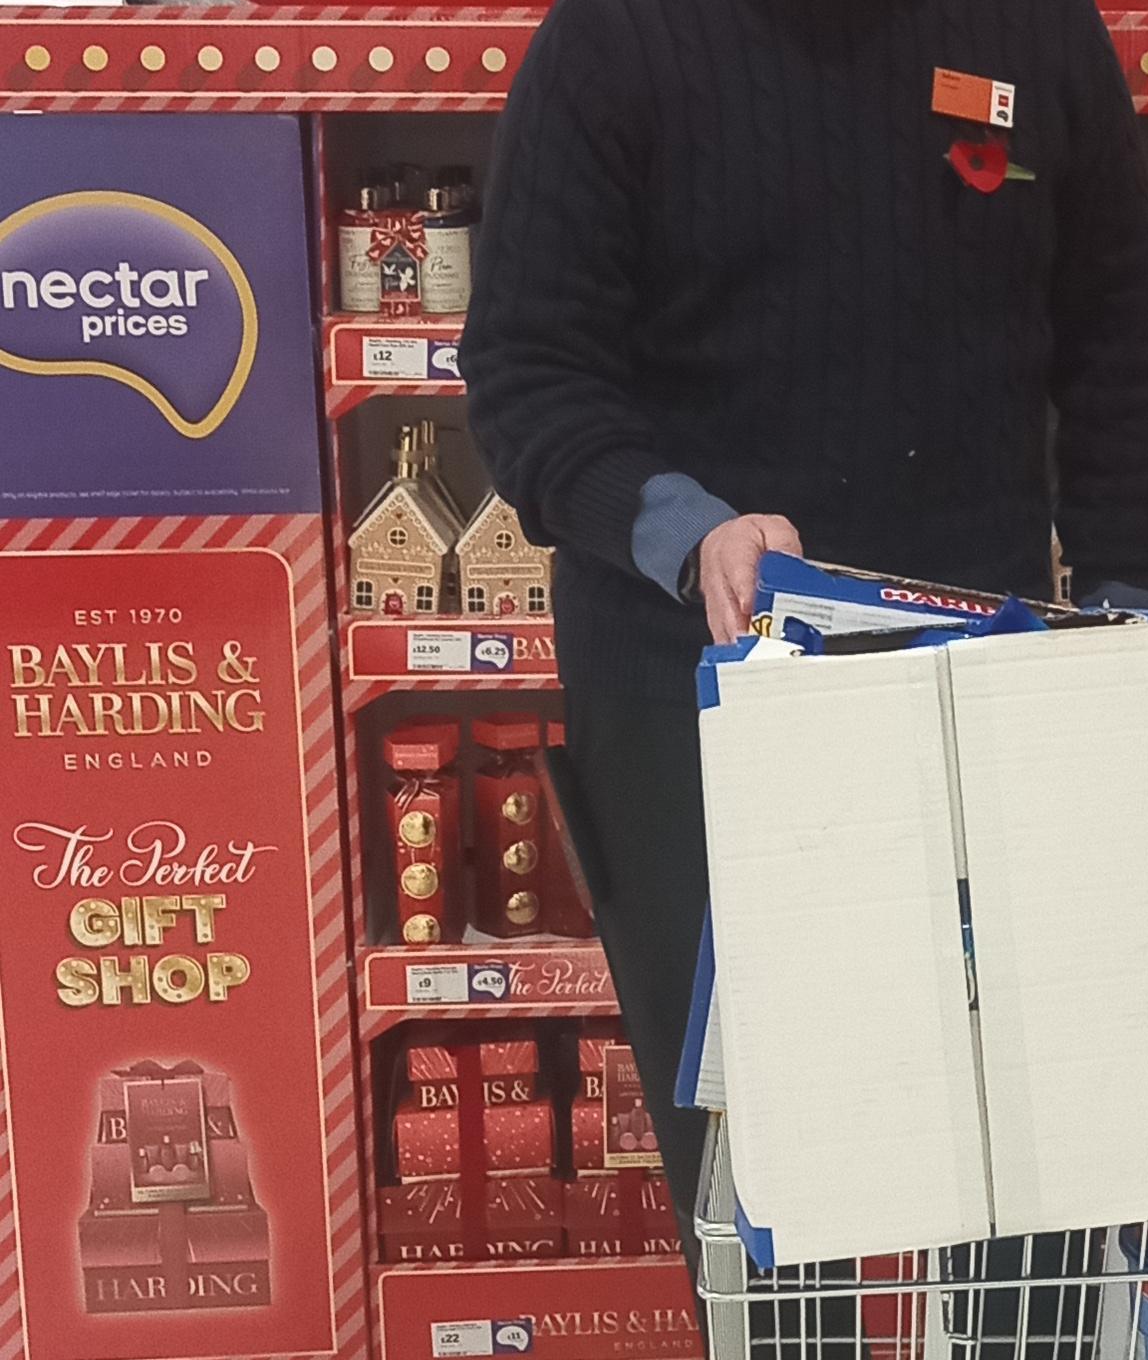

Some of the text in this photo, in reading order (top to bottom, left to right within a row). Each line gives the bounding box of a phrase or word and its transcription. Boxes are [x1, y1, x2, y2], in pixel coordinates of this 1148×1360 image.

[1, 262, 209, 310] nectar
[82, 308, 189, 343] prices
[74, 607, 183, 626] EST 1970
[881, 587, 997, 616] HARI
[9, 640, 260, 688] BAYLIS &
[513, 636, 556, 660] BAY
[11, 689, 266, 737] HARDING
[63, 749, 213, 771] ENGLAND
[13, 820, 279, 890] The Perfect
[69, 895, 226, 949] GIFT
[55, 953, 252, 1008] SHOP
[534, 959, 612, 996] Perfect
[511, 1080, 530, 1103] &
[627, 1312, 649, 1335] &
[613, 1339, 694, 1351] ENGLAND
